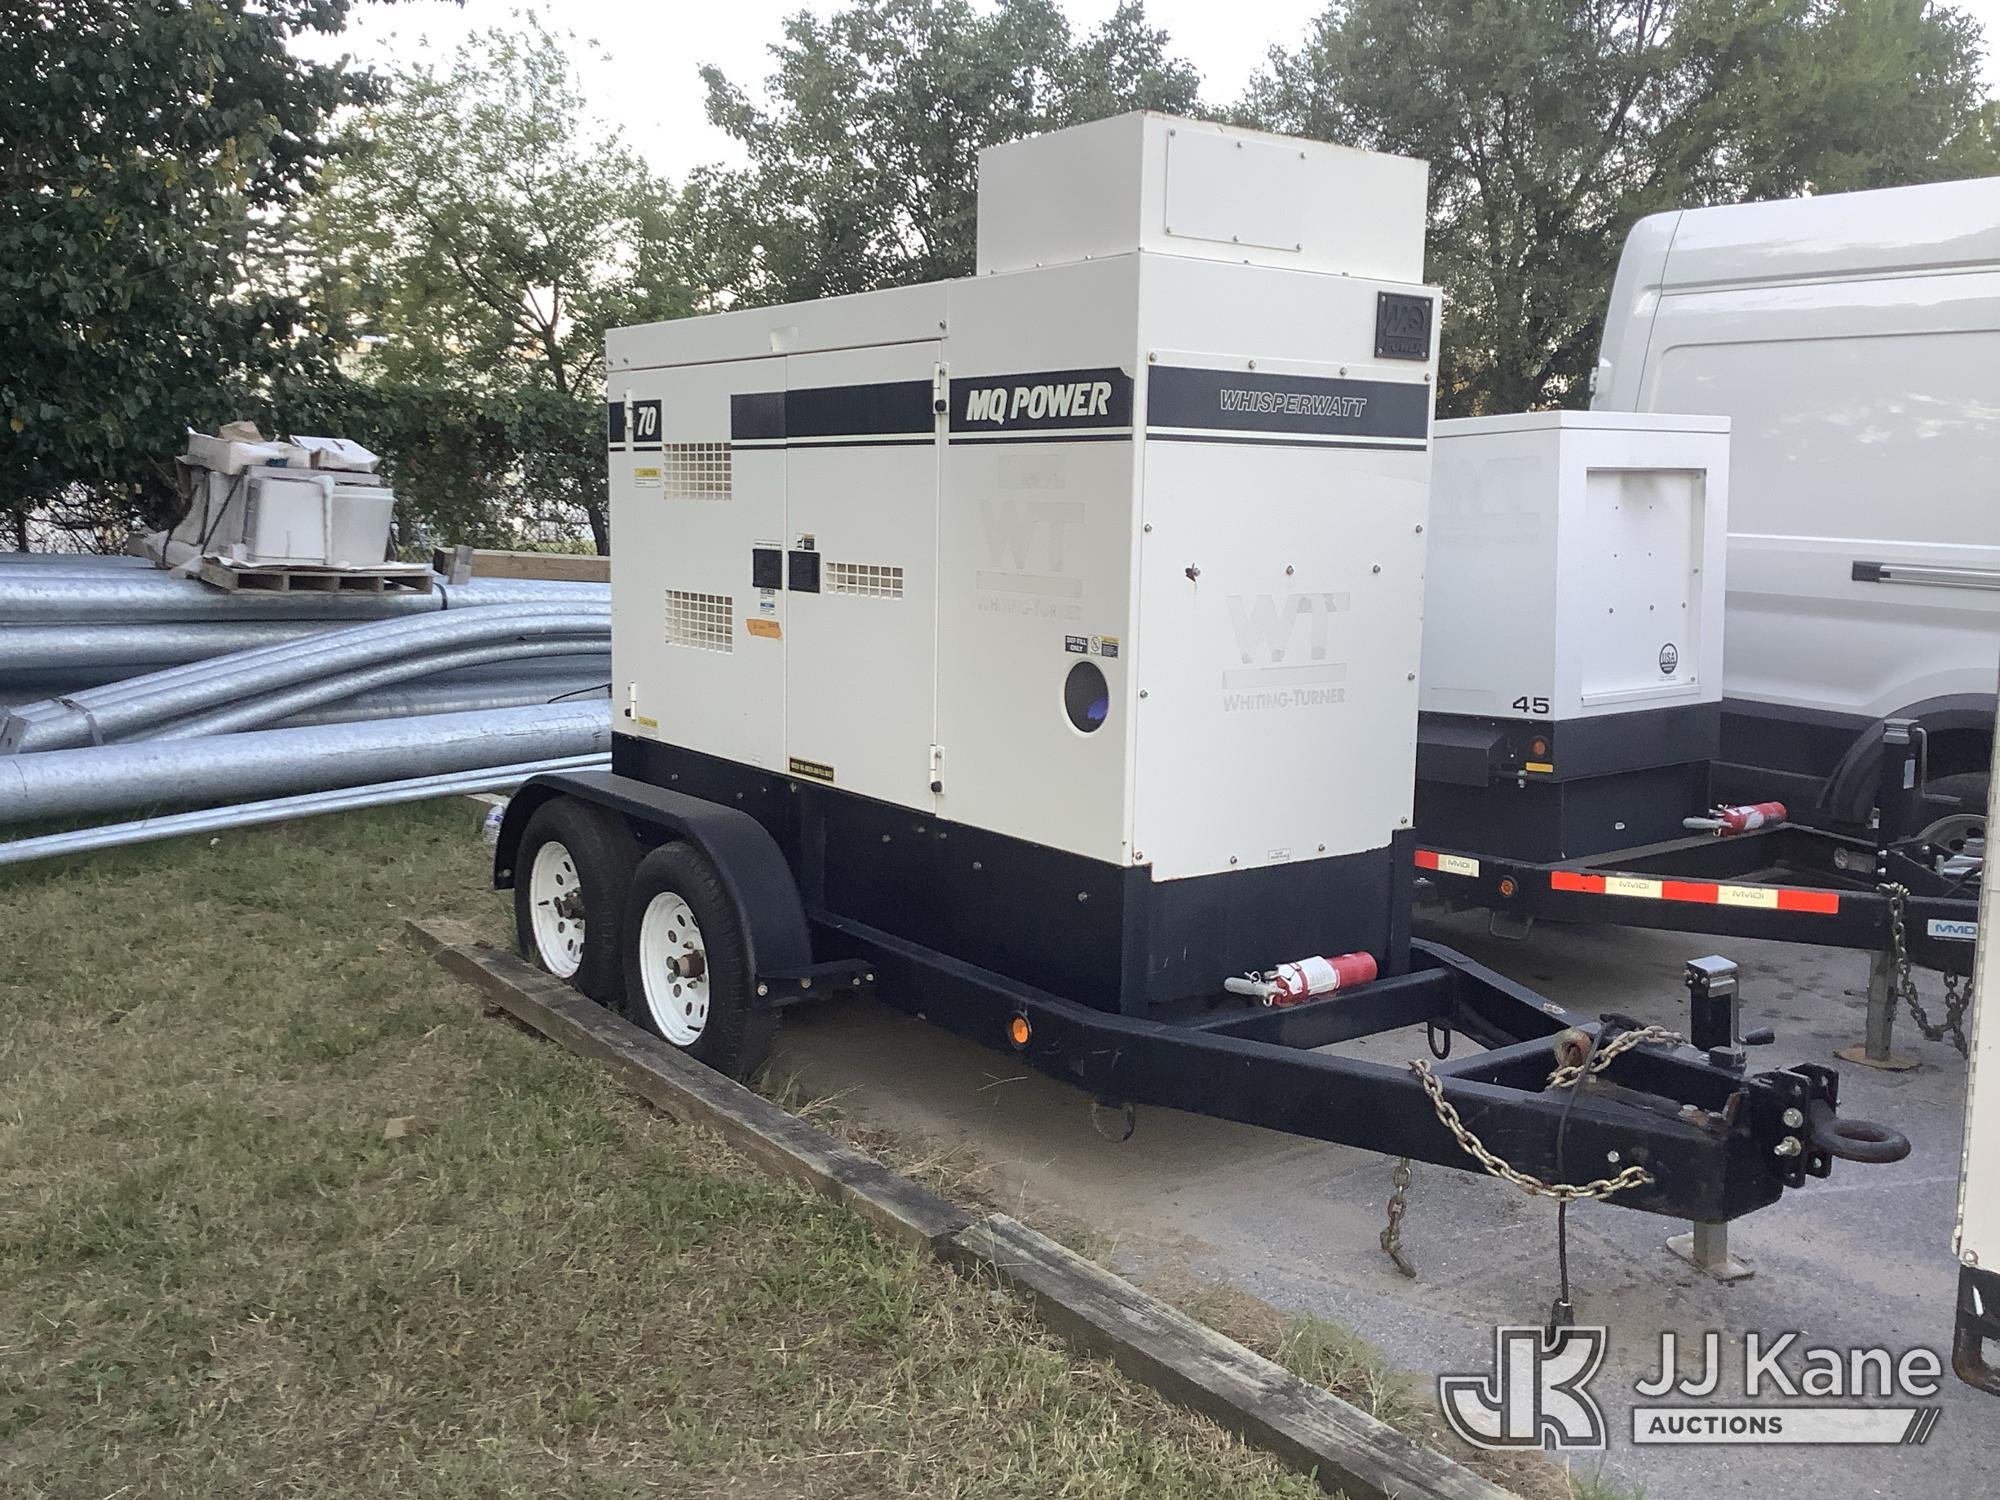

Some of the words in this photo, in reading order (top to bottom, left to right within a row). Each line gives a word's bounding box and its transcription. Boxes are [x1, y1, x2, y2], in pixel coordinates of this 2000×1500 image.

[966, 388, 1008, 425] MQ
[1010, 381, 1112, 420] POWER
[1220, 389, 1368, 418] WHISPERWATT
[637, 406, 657, 436] 70
[978, 501, 1085, 572] WT
[1224, 592, 1350, 664] WT
[1661, 651, 1676, 663] USA
[1512, 696, 1550, 715] 45
[1935, 924, 1977, 935] MMD
